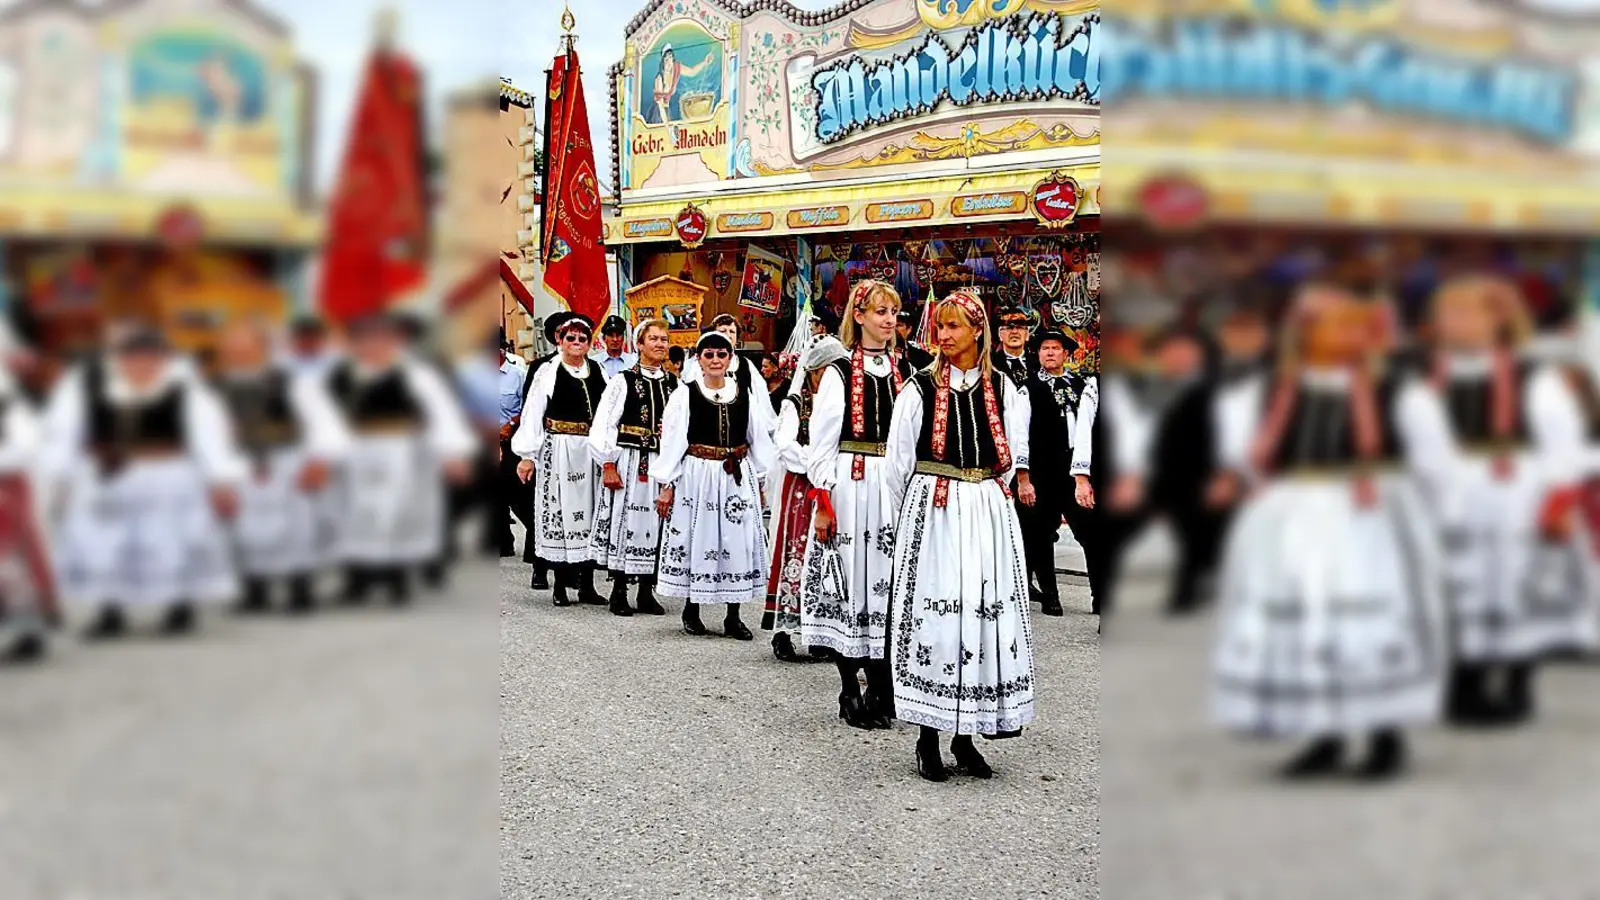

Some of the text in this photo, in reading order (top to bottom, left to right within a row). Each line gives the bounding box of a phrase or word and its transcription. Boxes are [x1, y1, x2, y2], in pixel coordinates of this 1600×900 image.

[632, 125, 727, 155] Gebr. Mandeln
[879, 203, 921, 221] Popcorn
